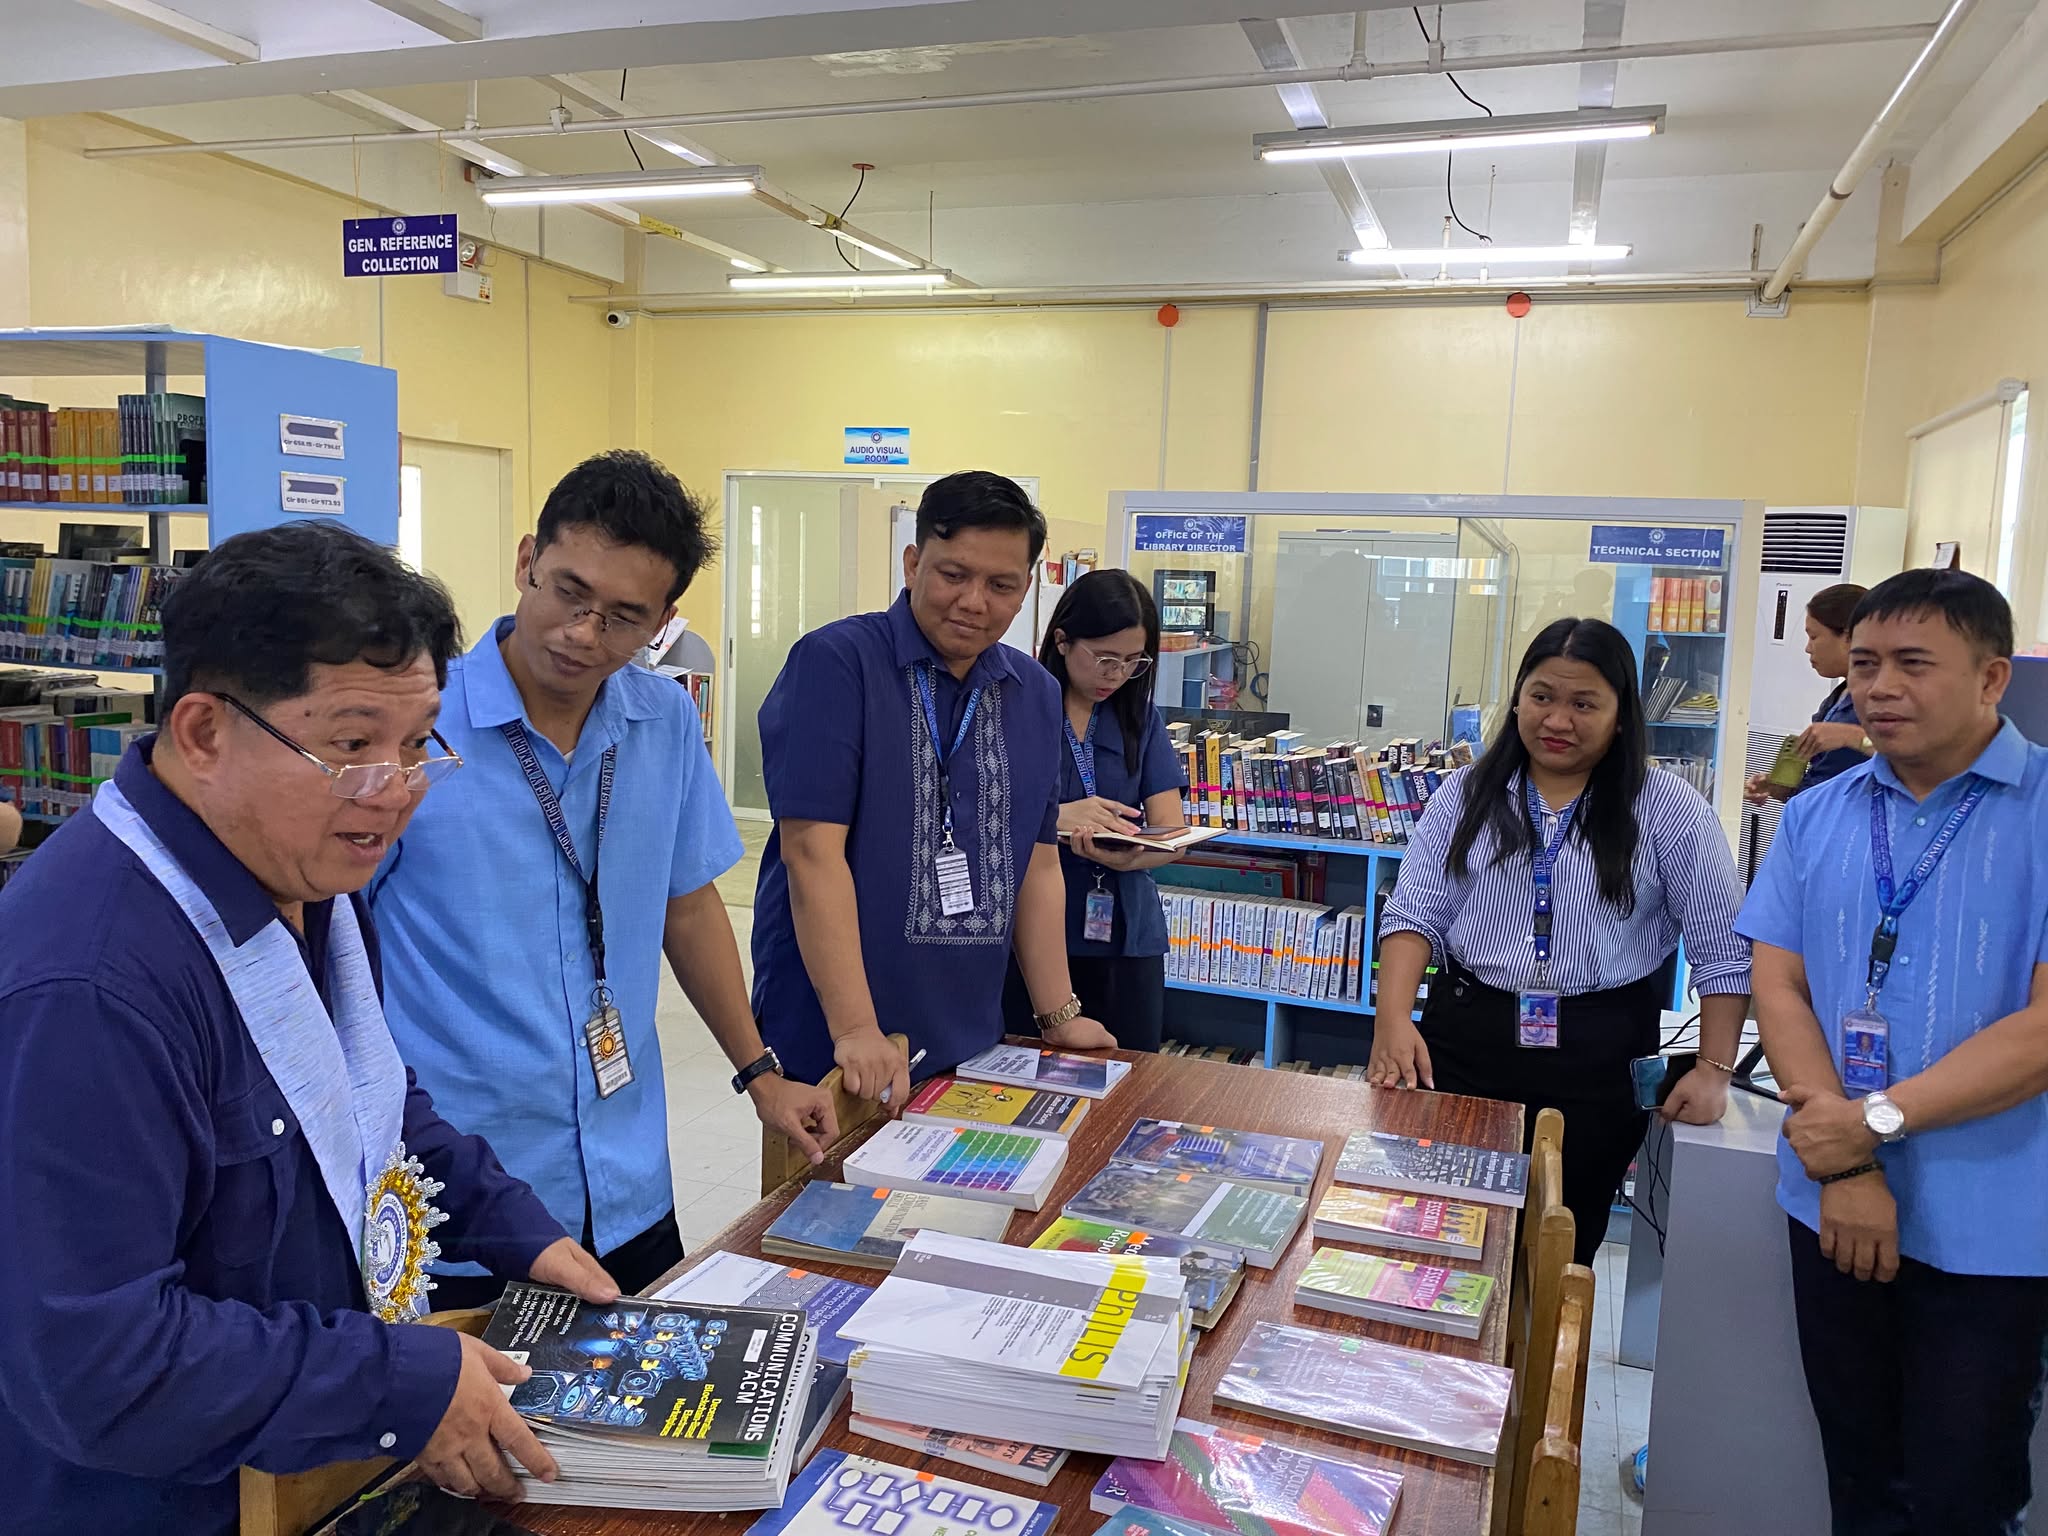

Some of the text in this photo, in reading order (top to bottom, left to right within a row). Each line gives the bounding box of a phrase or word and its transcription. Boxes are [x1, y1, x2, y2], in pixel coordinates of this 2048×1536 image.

[349, 234, 452, 253] GEN. REFERENCE
[362, 256, 439, 273] COLLECTION
[850, 446, 874, 454] AUDIO
[1143, 543, 1236, 552] LIBRARY DIRECTOR
[1156, 531, 1188, 539] OFFICE
[1206, 532, 1224, 540] THE
[1592, 546, 1720, 559] TECHNICAL SECTION
[530, 774, 564, 830] MAGSAYSAY
[557, 832, 578, 864] RAMON
[1421, 1200, 1443, 1233] ESSENTIAL
[1414, 1267, 1444, 1300] ESSENTIAL
[735, 1369, 761, 1405] ACM
[743, 1312, 798, 1443] COMMUNICATIONS
